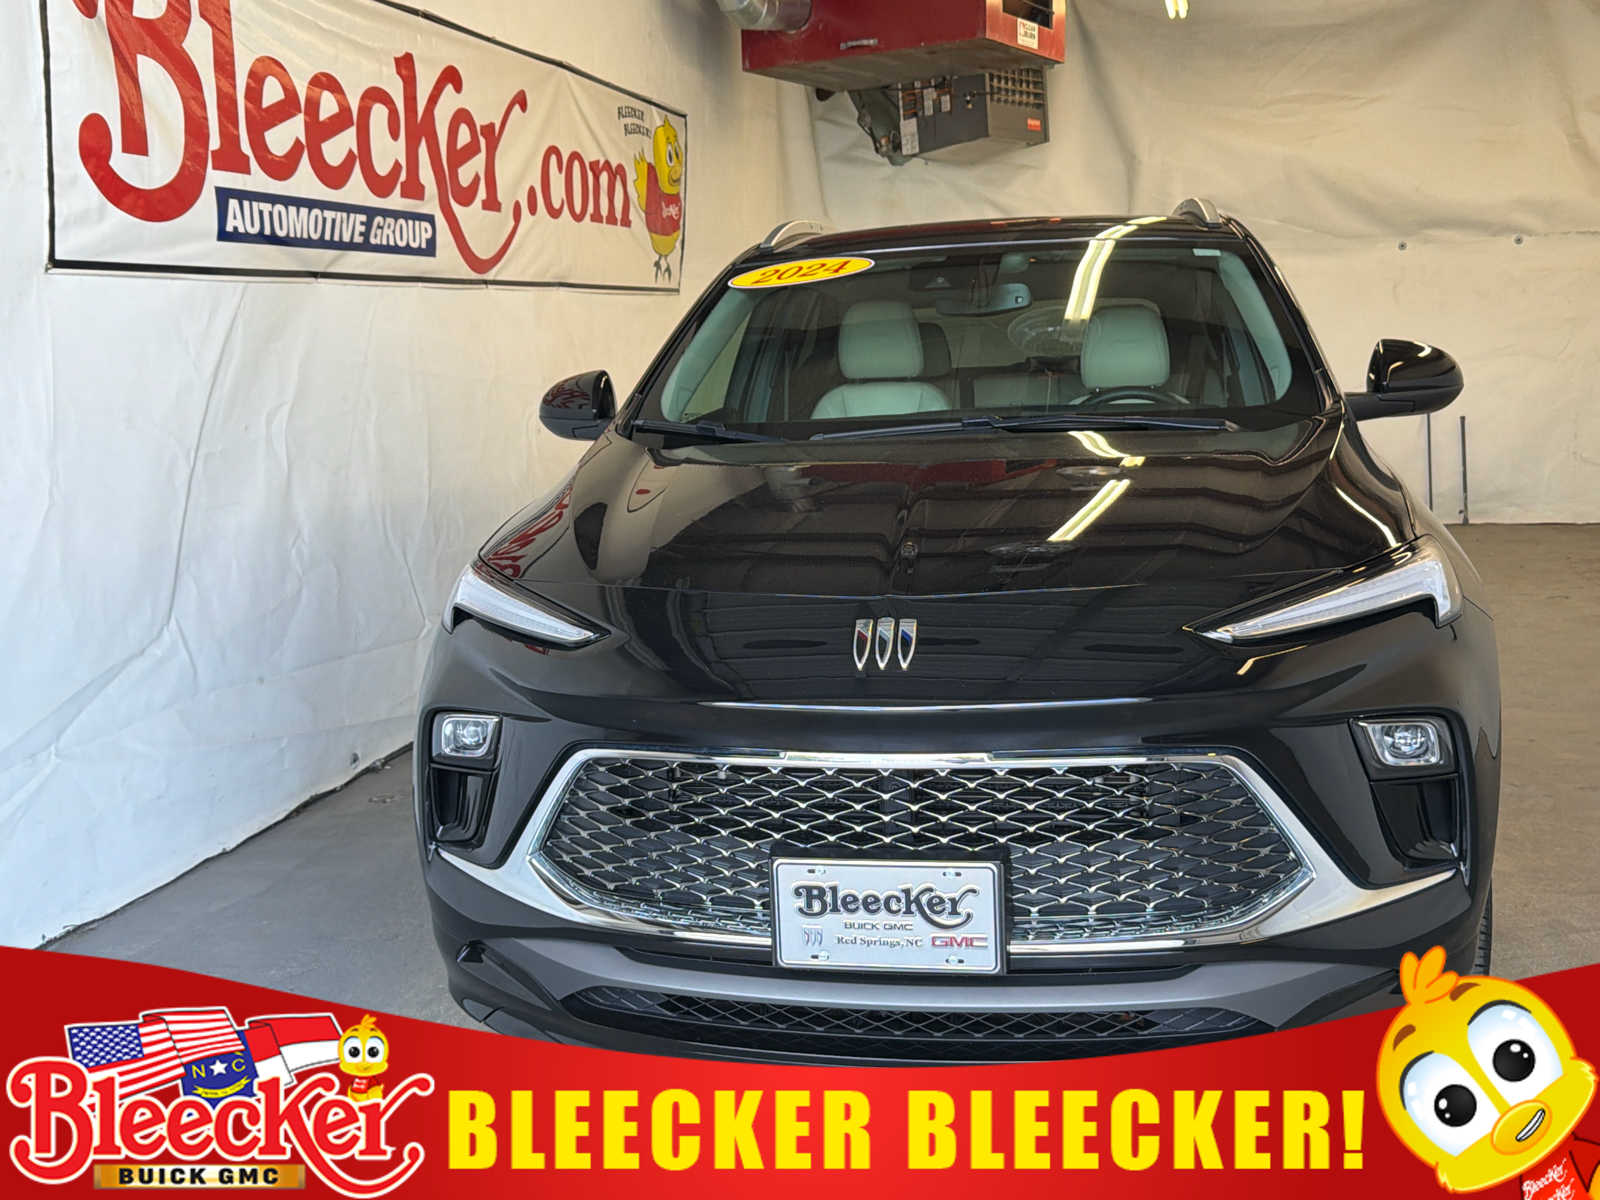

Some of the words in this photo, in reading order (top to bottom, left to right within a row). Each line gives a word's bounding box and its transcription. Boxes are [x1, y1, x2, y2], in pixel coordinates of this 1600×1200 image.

[225, 198, 367, 243] AUTOMOTIVE
[369, 216, 433, 249] GROUP
[752, 260, 851, 285] 2024
[793, 881, 980, 930] Bleecker
[844, 921, 880, 931] BUICK
[883, 922, 913, 931] GMC
[836, 935, 859, 945] Red
[931, 935, 989, 948] GMC
